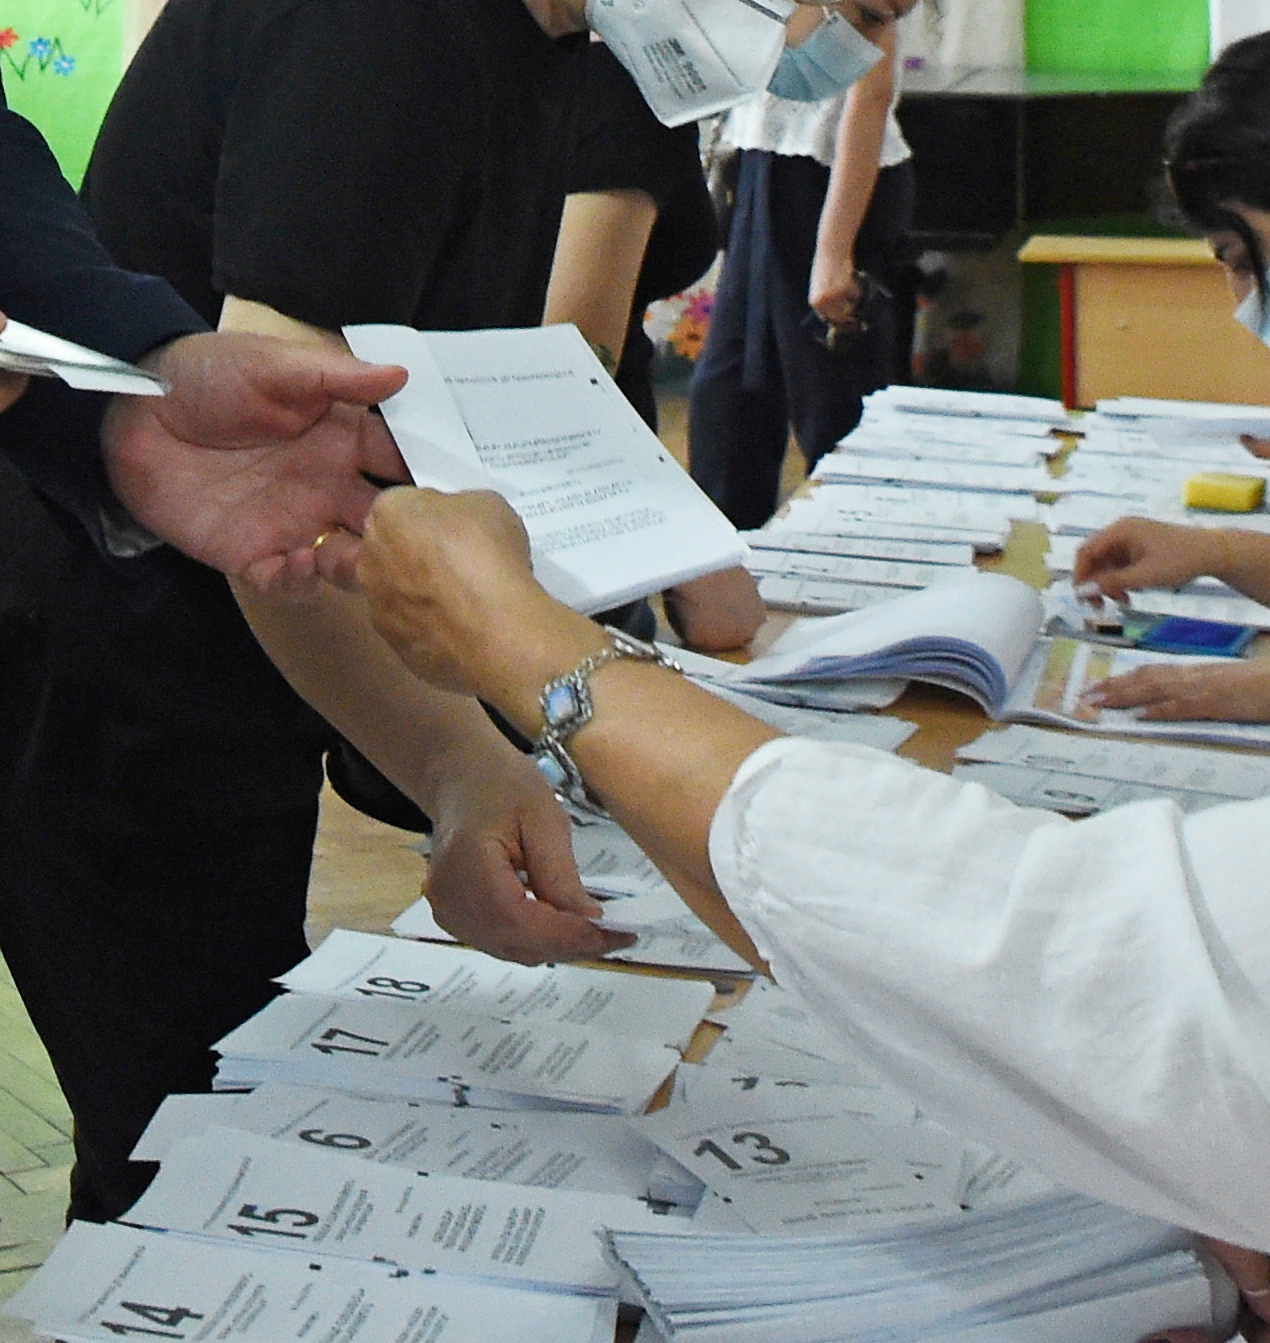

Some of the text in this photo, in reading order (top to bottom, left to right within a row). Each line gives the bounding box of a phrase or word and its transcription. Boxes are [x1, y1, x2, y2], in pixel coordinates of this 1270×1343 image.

[354, 976, 431, 1001] 18
[310, 1027, 390, 1056] 17
[692, 1130, 791, 1170] 13
[226, 1203, 320, 1239] 15
[100, 1300, 205, 1340] 14
